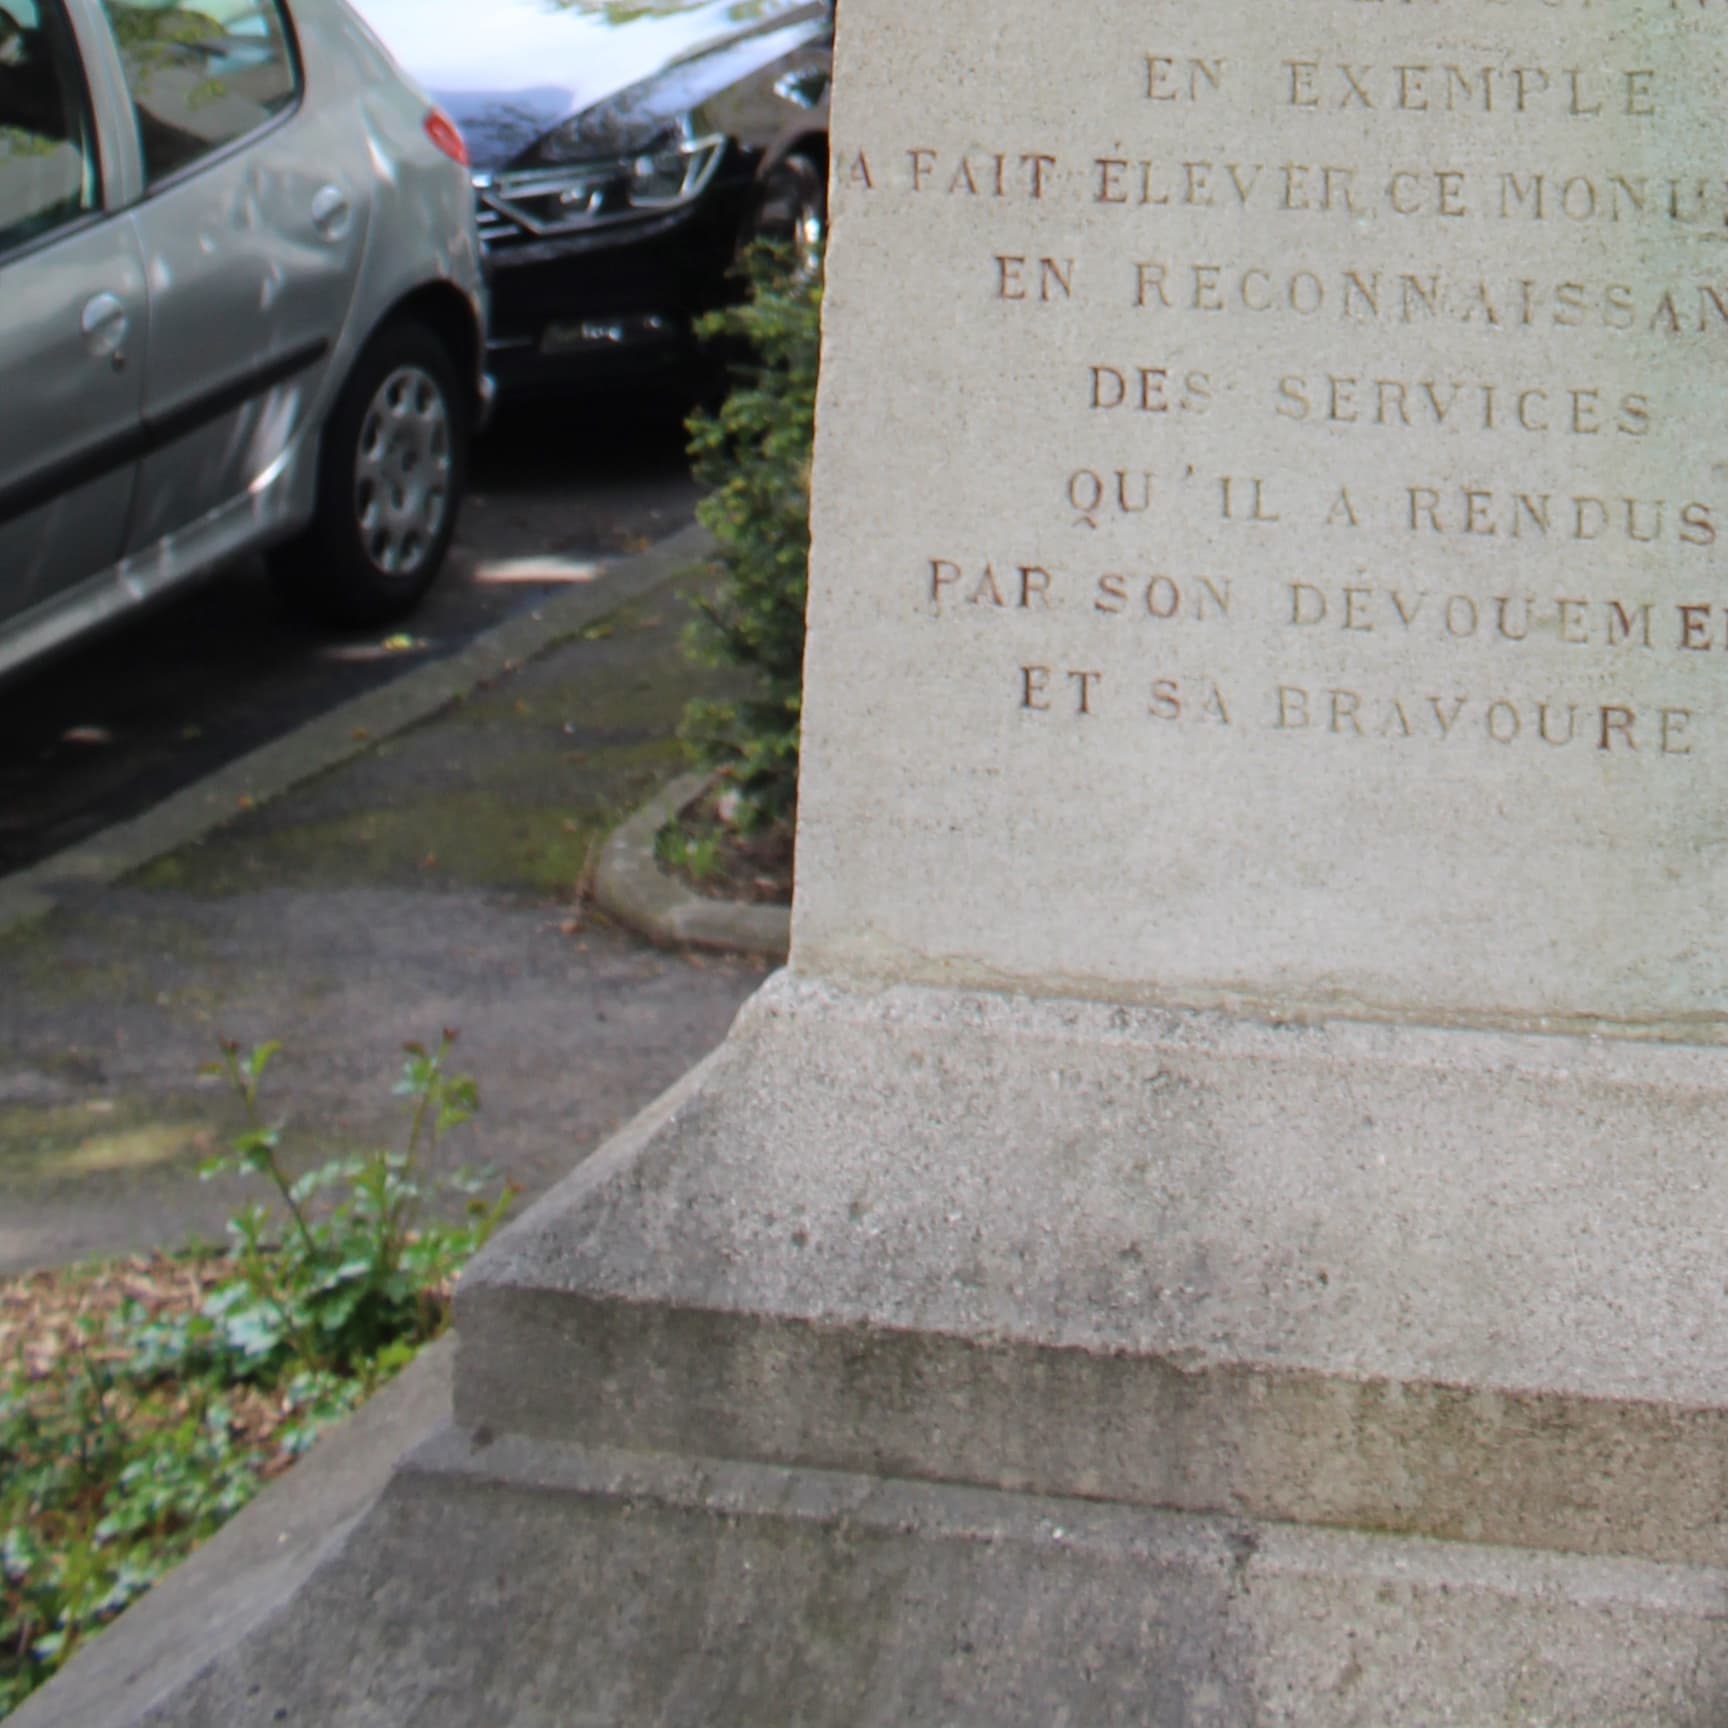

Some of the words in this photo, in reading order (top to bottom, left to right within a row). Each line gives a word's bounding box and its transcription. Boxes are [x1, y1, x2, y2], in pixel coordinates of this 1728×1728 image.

[1145, 55, 1226, 106] EN
[1287, 60, 1656, 119] EXEMPLE
[848, 150, 876, 190] A
[907, 150, 1056, 198] FAIT
[1383, 169, 1467, 219] CE
[996, 255, 1076, 300] EN
[1088, 365, 1213, 412] DES
[1276, 374, 1653, 435] SERVICES
[1325, 484, 1359, 528] A
[1405, 485, 1719, 546] RENDUS
[928, 558, 1056, 610] PAR
[1093, 571, 1232, 618] SON
[1018, 665, 1104, 714] ET
[1149, 676, 1231, 723] SA
